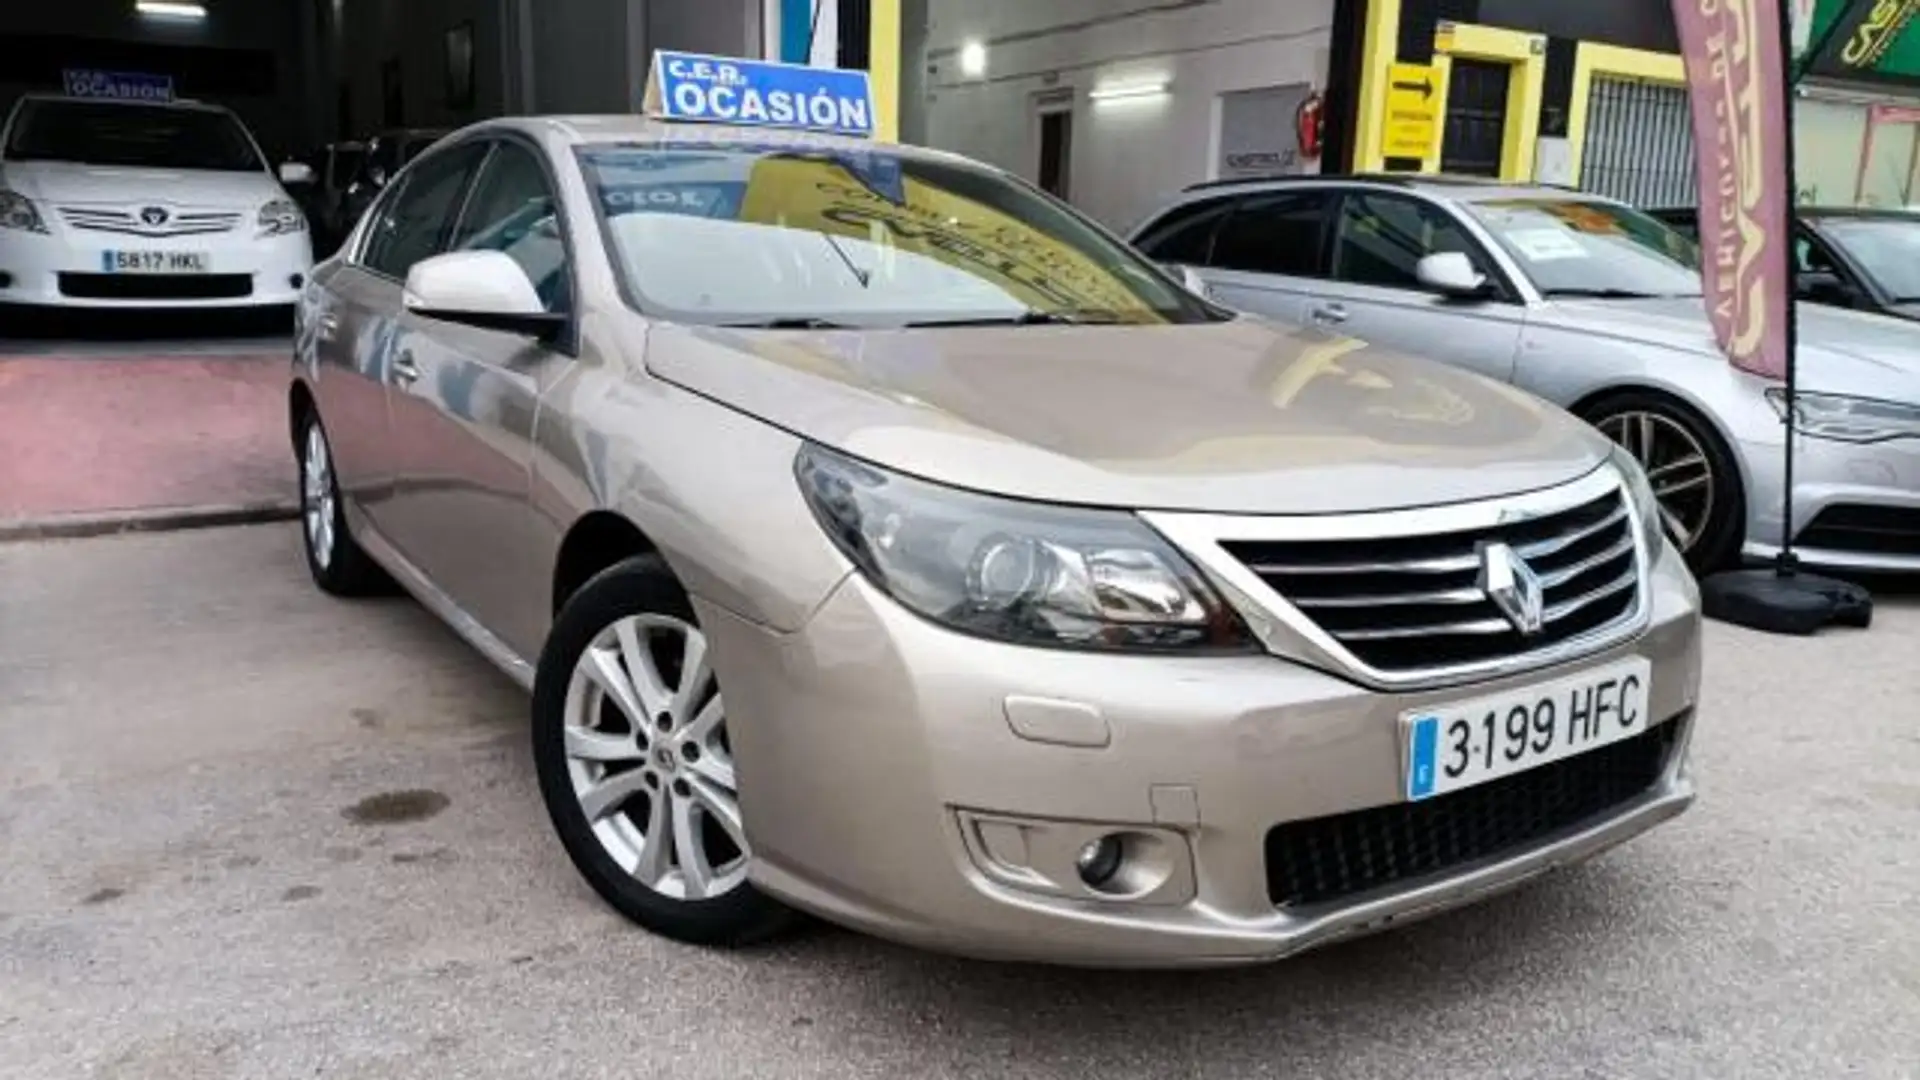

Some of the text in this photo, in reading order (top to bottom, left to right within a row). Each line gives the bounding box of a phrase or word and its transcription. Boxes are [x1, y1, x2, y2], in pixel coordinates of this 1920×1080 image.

[674, 83, 869, 127] OCASIÓN
[116, 251, 163, 269] 5817
[1567, 674, 1640, 745] HFC
